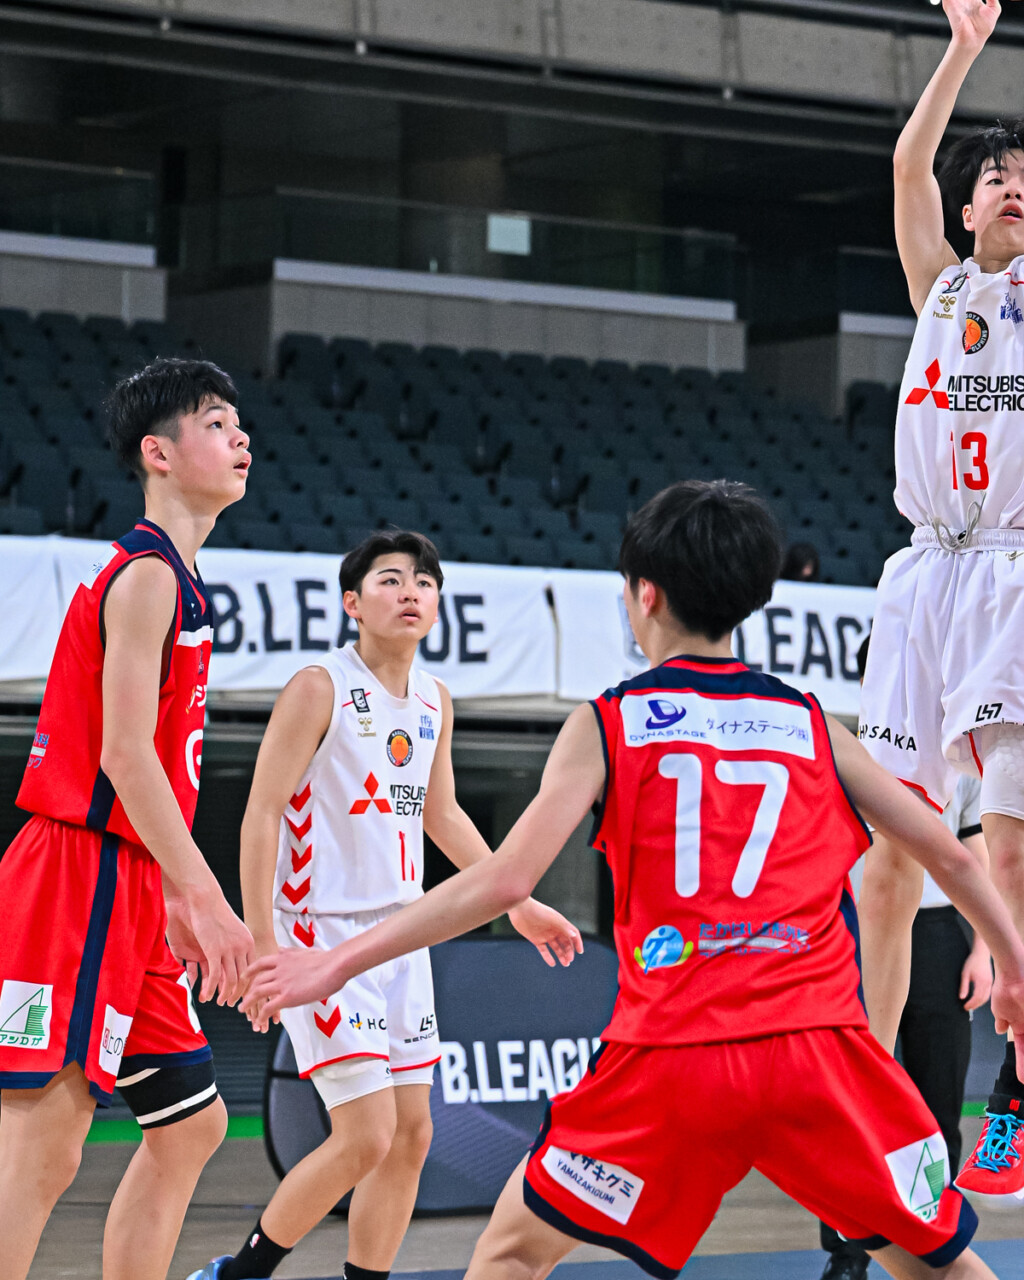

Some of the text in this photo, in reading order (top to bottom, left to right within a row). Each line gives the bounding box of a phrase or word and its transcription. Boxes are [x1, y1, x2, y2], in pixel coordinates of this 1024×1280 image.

[205, 579, 489, 663] B.LEUE
[630, 729, 707, 741] DYNASTAGE
[658, 753, 789, 898] 17
[557, 1159, 615, 1204] YAMAZAKIGUMI
